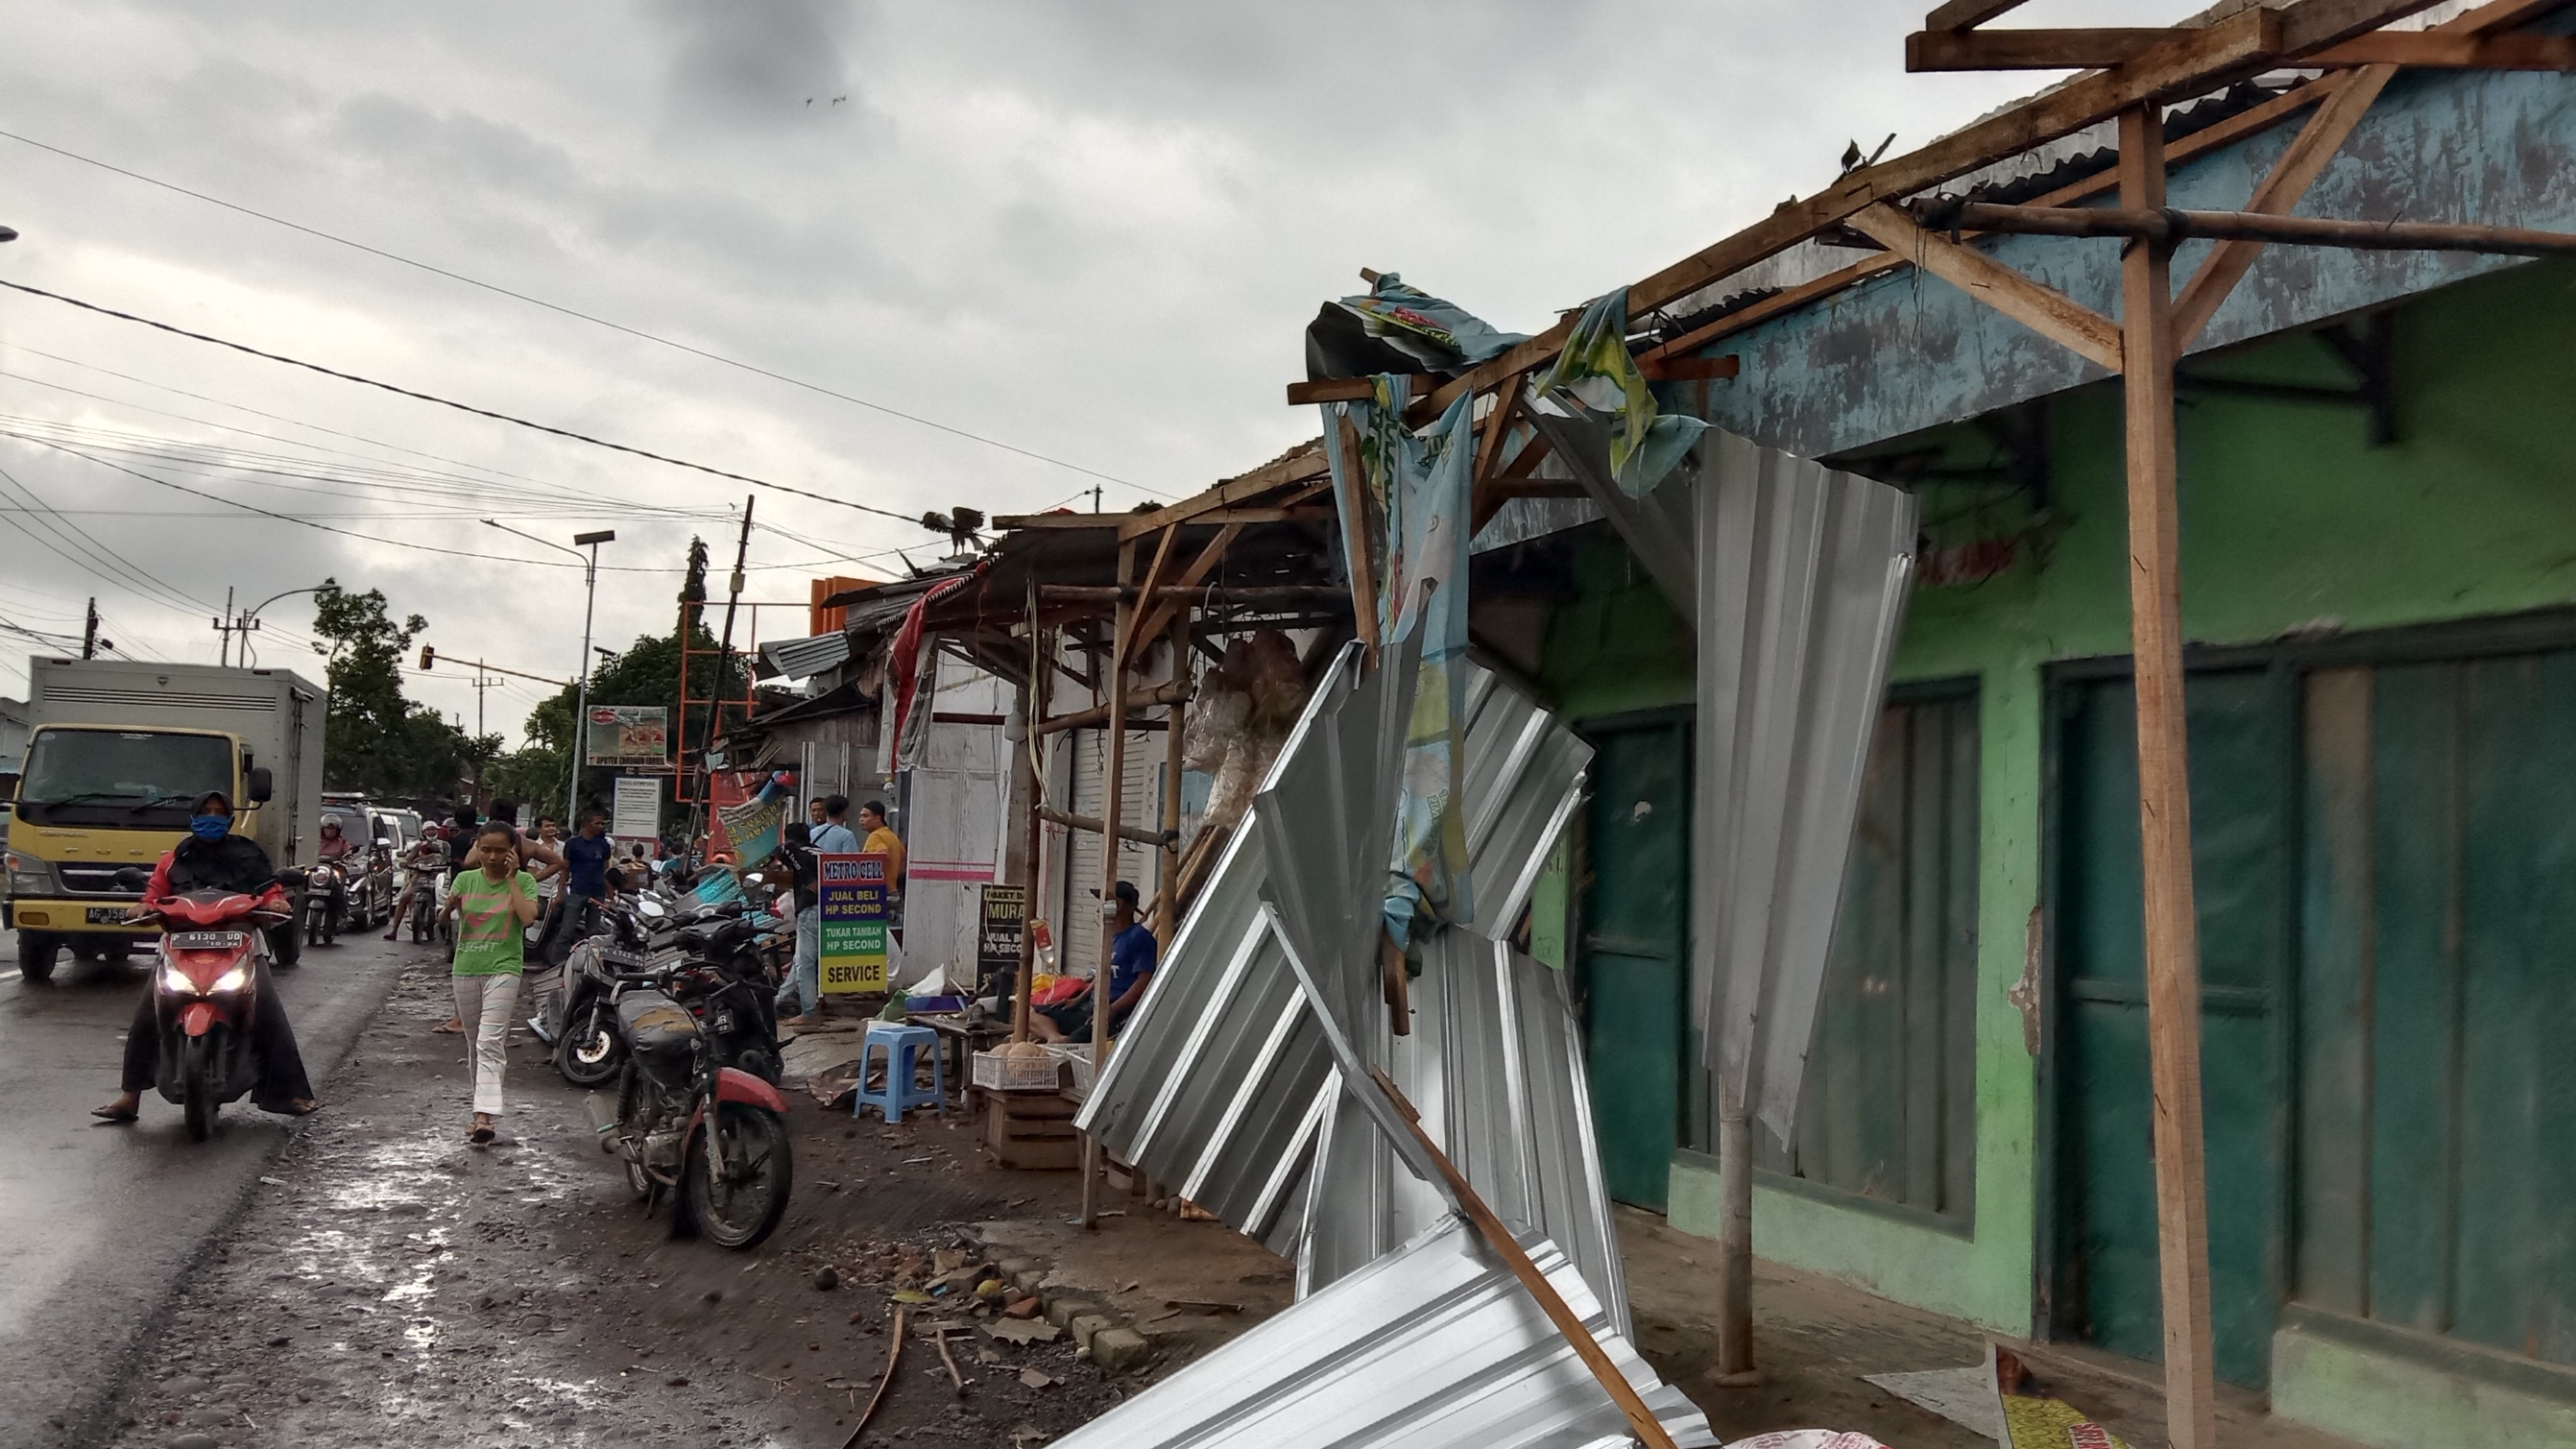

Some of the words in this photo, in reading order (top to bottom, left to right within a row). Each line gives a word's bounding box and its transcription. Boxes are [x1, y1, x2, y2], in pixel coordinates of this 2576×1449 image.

[824, 860, 858, 881] METRO
[859, 860, 884, 880] CELL
[829, 891, 854, 902] JUAL
[856, 890, 879, 901] BELI
[89, 908, 101, 919] AG
[108, 908, 129, 920] 156
[826, 905, 839, 915] HP
[842, 904, 881, 914] SECOND
[826, 928, 851, 938] TUKAR
[853, 927, 881, 936] TAMBAH
[827, 941, 840, 951] HP
[842, 940, 881, 950] SECOND
[828, 965, 879, 983] SERVICE
